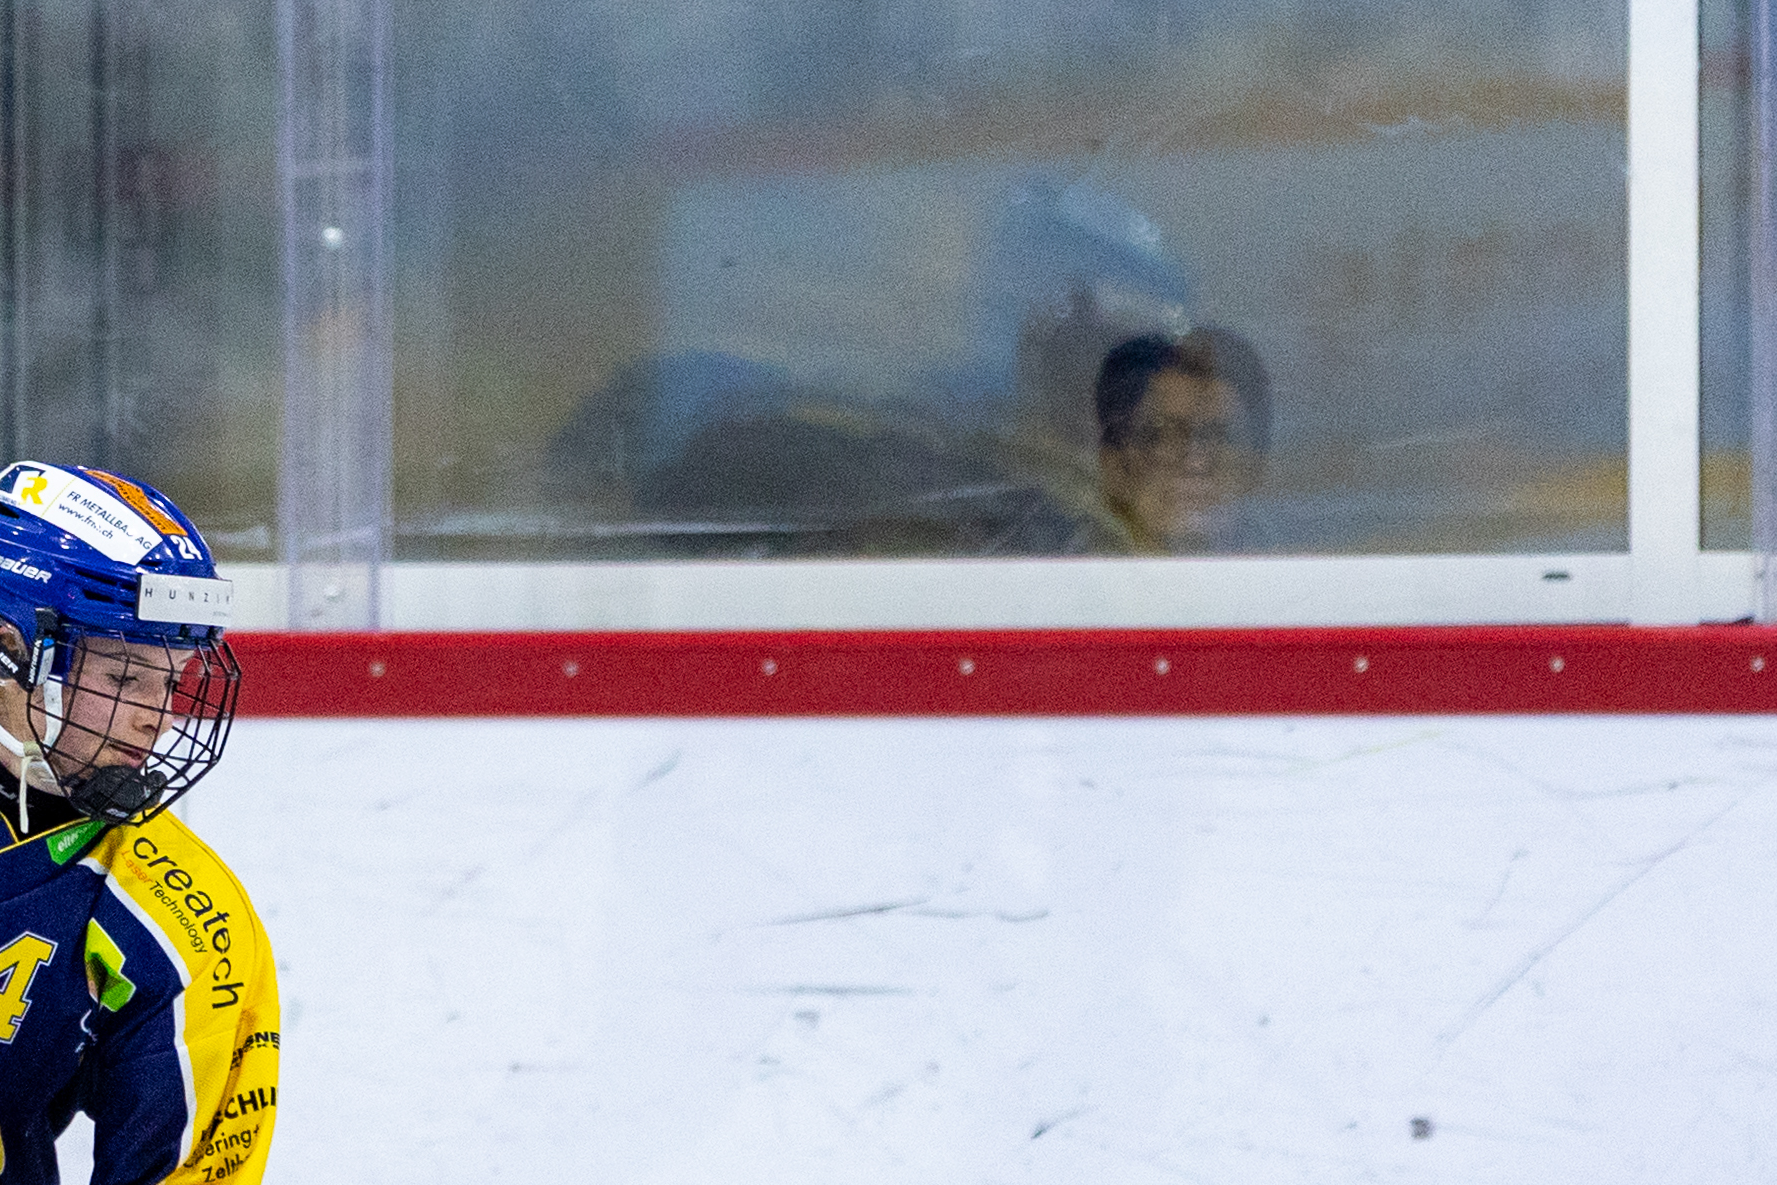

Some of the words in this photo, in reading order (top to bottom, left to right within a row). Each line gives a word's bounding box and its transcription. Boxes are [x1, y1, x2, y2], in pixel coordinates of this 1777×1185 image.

[135, 536, 153, 550] AG
[122, 850, 153, 883] Laser
[149, 881, 208, 954] Technology
